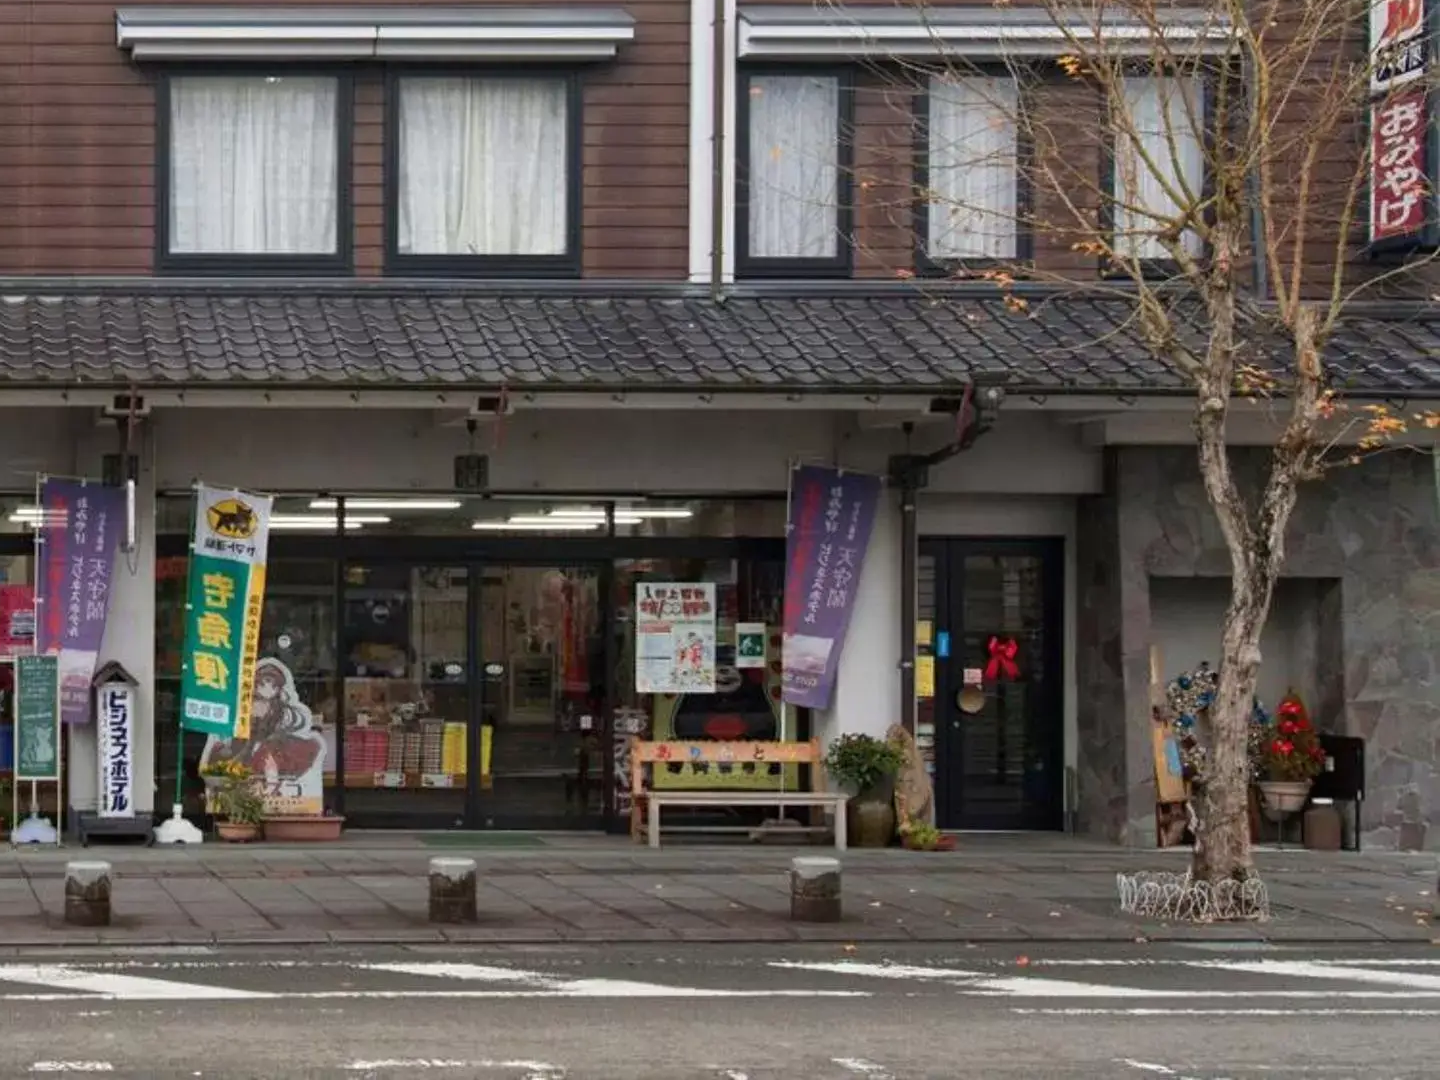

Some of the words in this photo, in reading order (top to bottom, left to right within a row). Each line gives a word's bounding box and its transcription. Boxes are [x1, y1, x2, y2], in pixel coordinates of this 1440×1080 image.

[109, 691, 128, 812] ビジネスホテル
